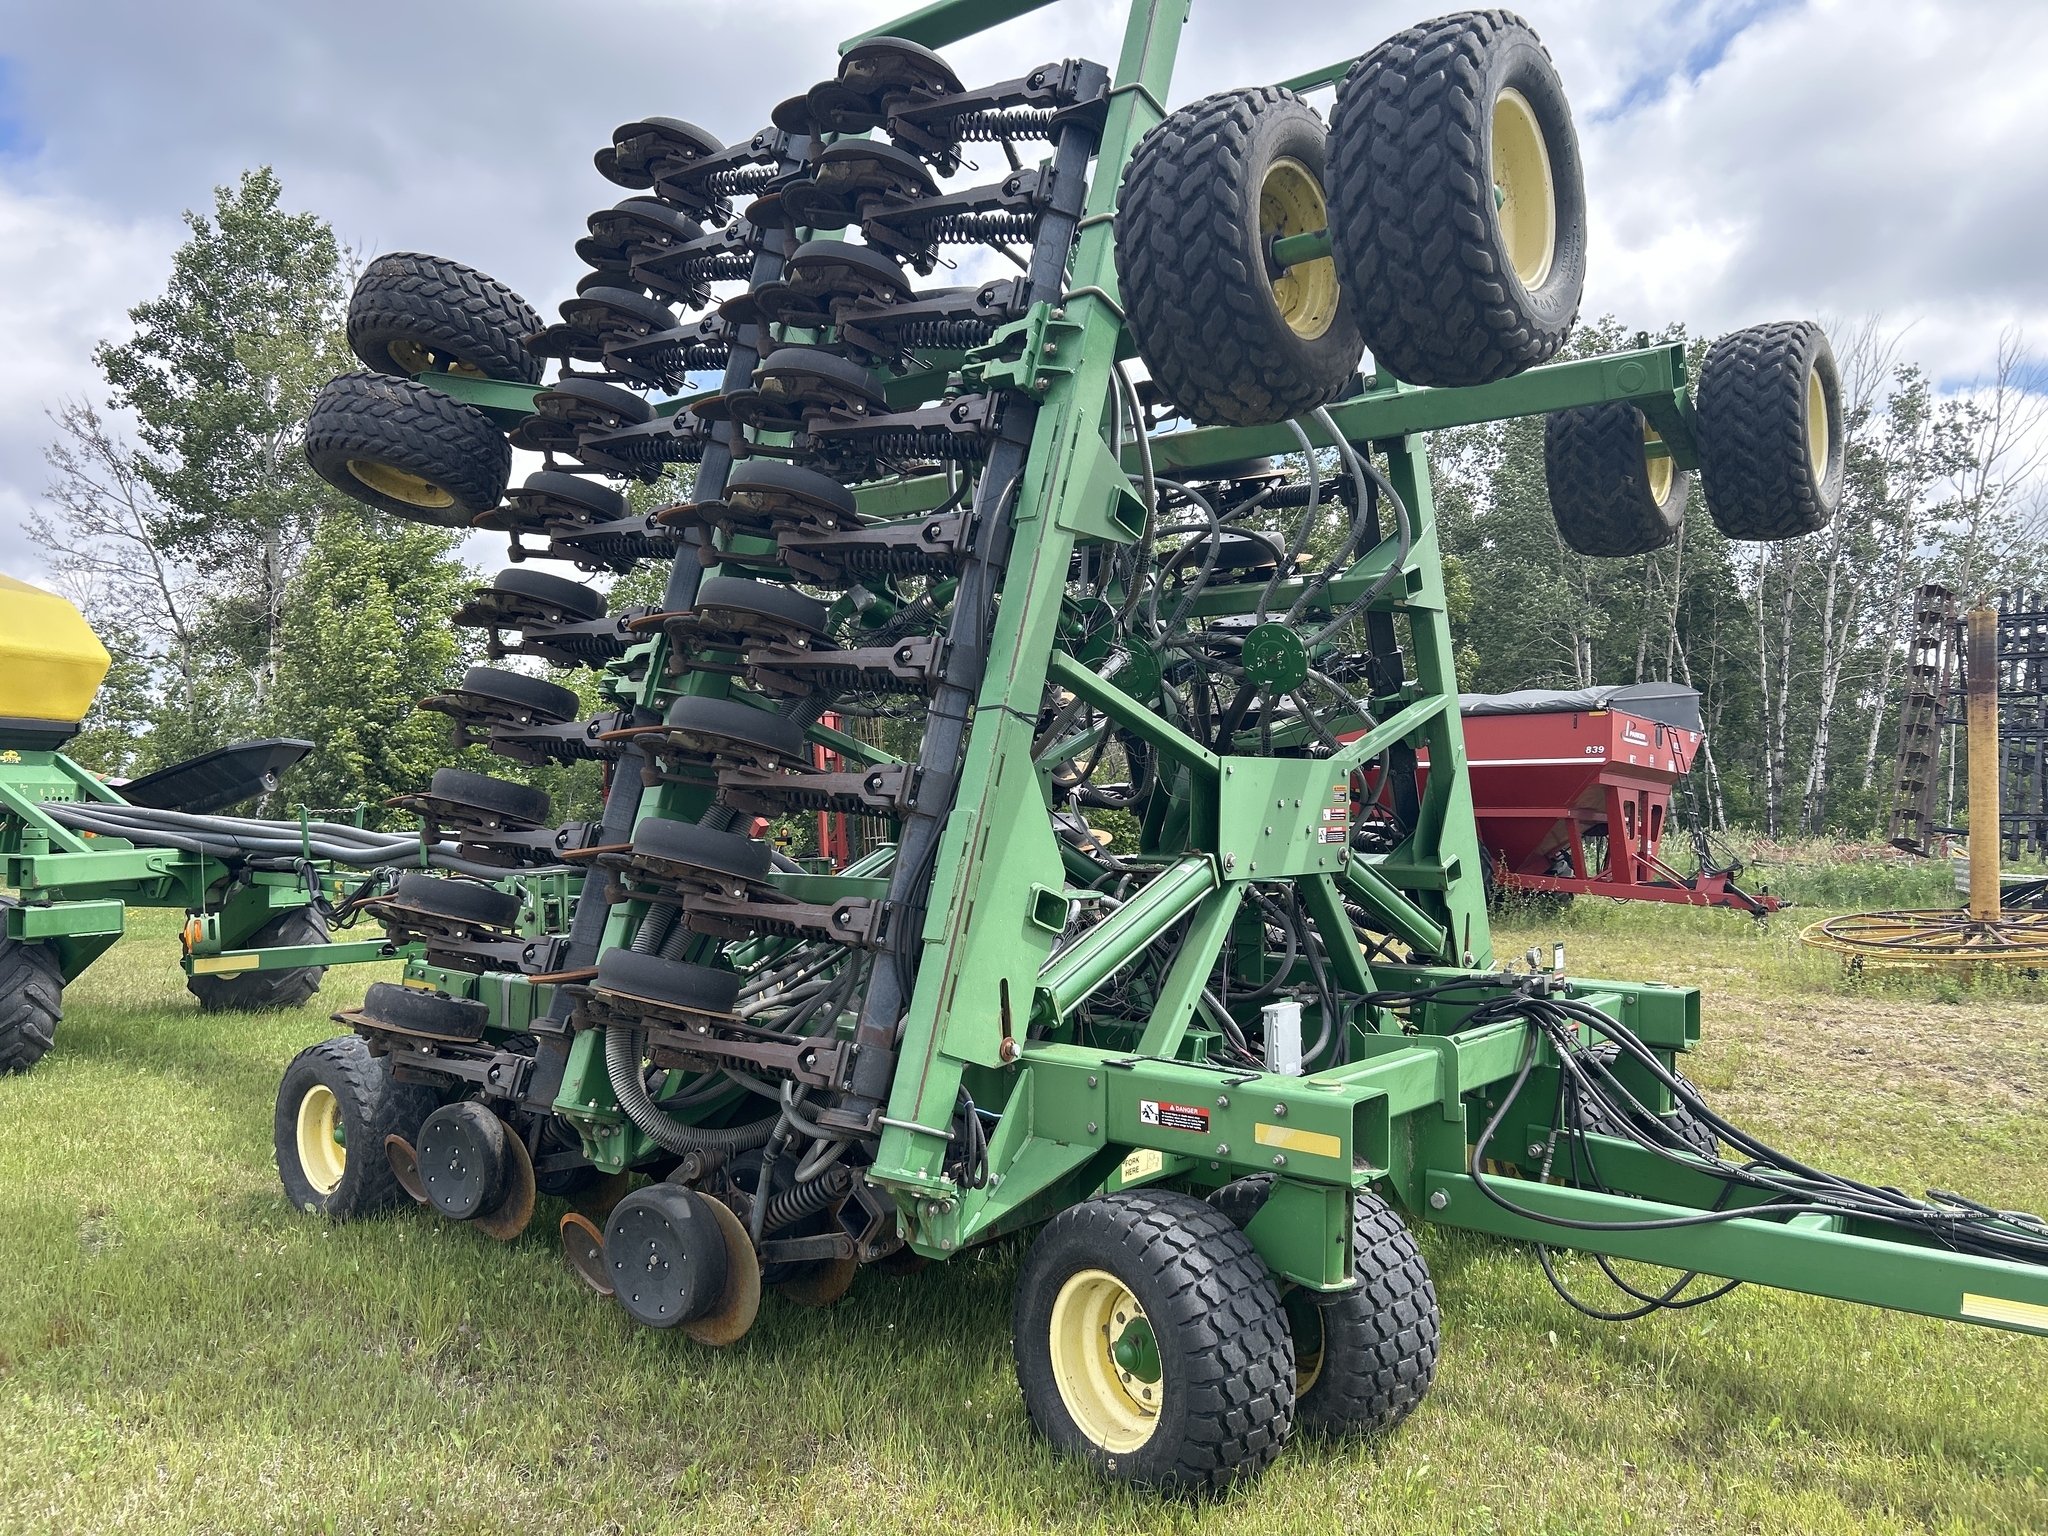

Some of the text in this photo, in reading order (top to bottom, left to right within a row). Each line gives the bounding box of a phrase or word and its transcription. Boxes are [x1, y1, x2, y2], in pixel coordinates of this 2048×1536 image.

[1585, 745, 1605, 754] 839
[1175, 1105, 1199, 1115] DANGER
[1125, 1156, 1140, 1167] FORK
[1125, 1165, 1140, 1177] HERE
